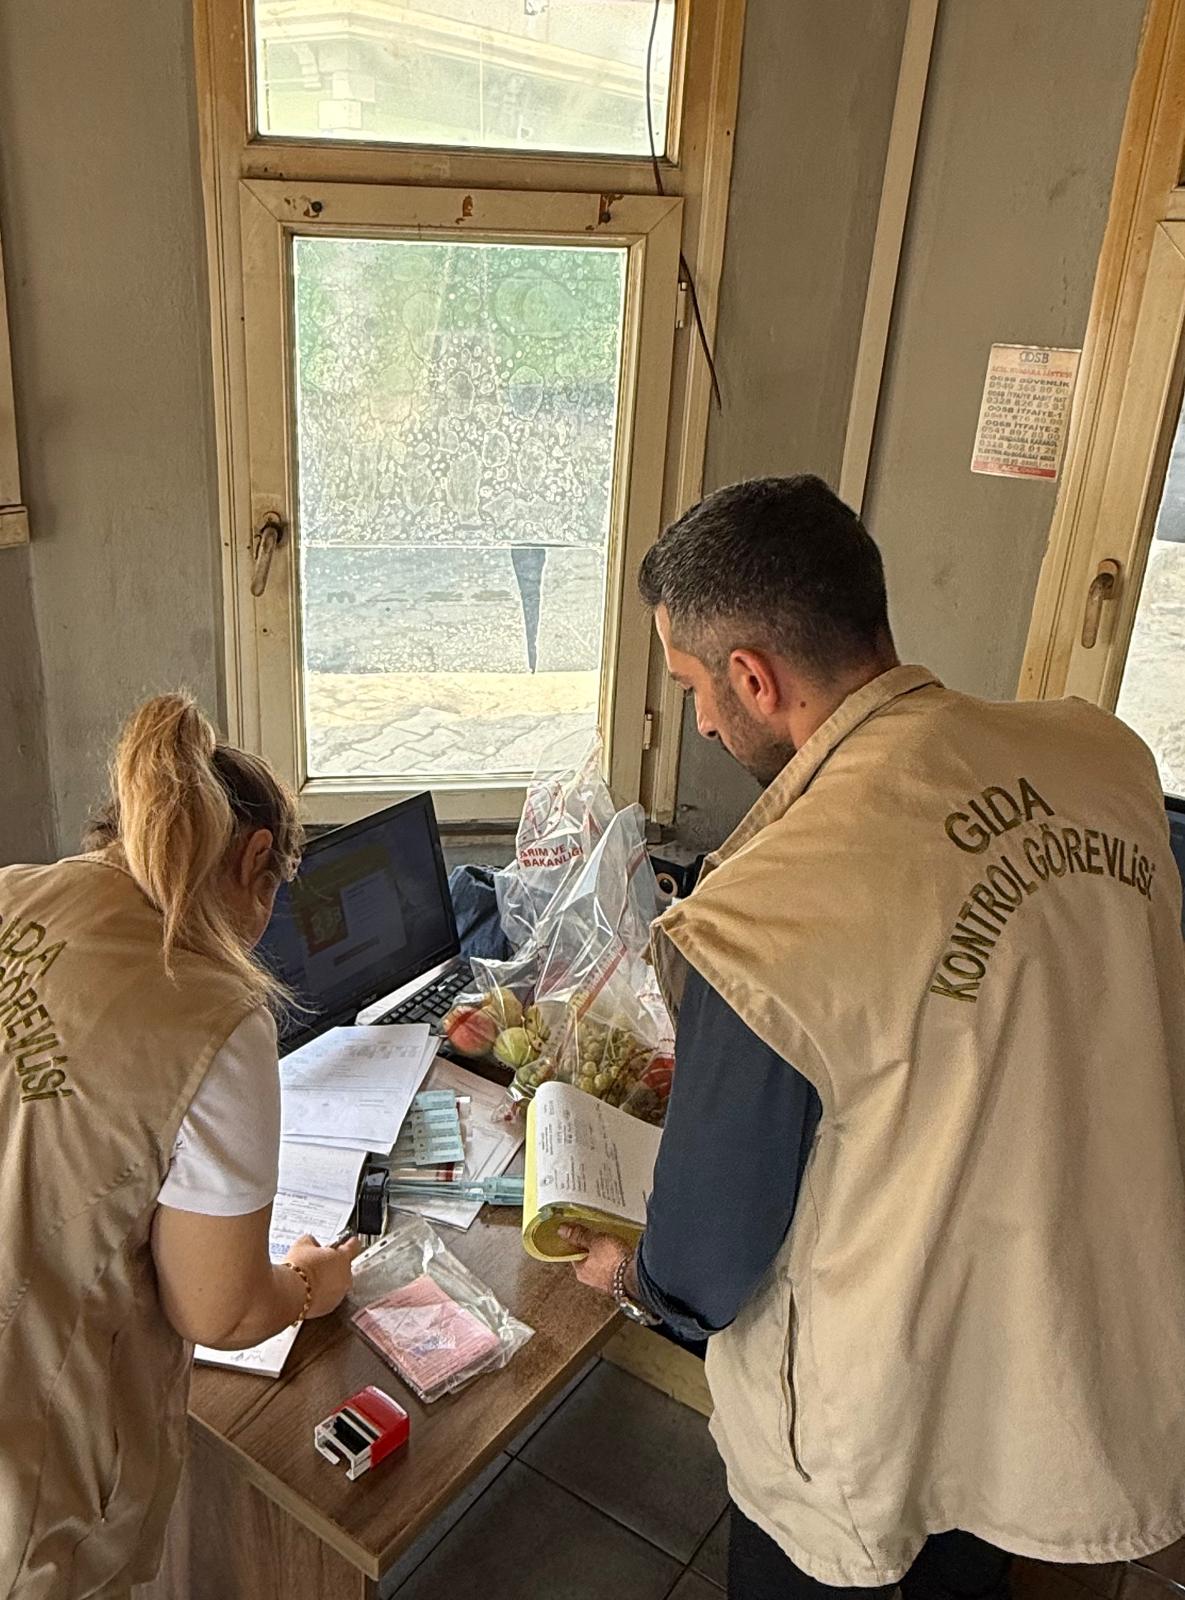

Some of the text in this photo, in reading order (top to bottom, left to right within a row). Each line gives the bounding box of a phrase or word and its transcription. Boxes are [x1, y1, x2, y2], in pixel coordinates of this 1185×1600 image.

[1020, 377, 1070, 387] GÜVENLİK
[1015, 421, 1060, 433] İTFAİYE-2
[1017, 408, 1062, 418] İTFAİYE-1
[944, 777, 1055, 855] GIDA
[520, 844, 566, 859] ARIM VE
[930, 823, 1156, 1003] KONTROL GÖREVLİSİ
[0, 914, 68, 977] IDA
[0, 966, 73, 1103] ÖREVLİSİ
